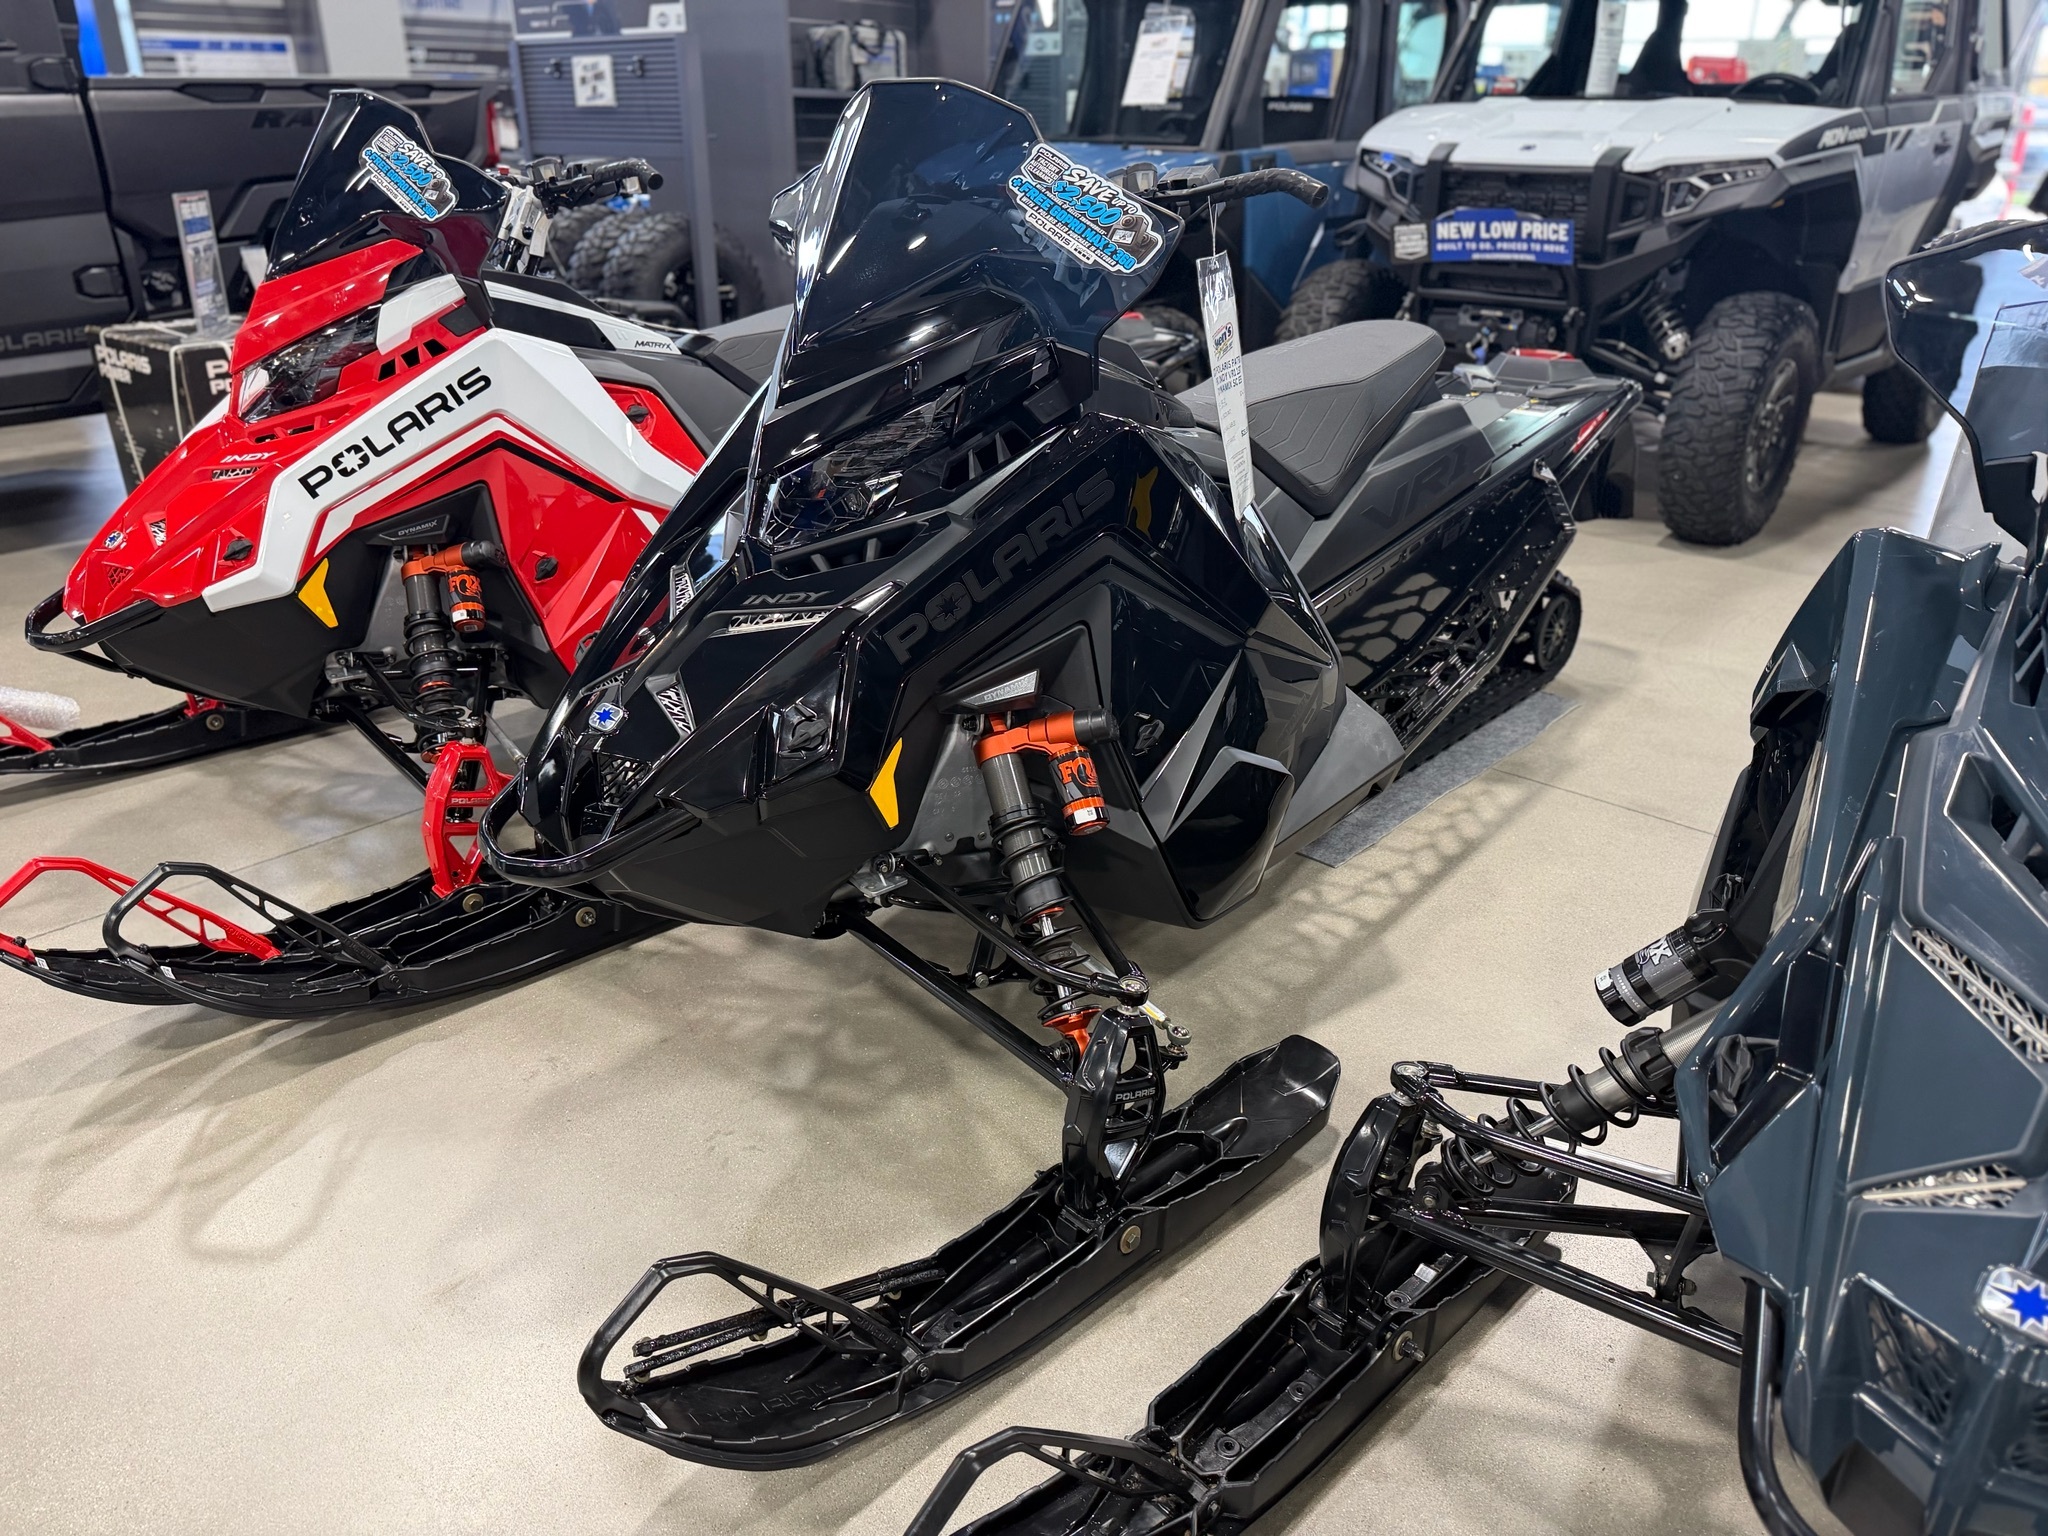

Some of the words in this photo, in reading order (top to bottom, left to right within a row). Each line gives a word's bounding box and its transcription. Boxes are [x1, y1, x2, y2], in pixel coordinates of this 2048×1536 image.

[398, 143, 431, 168] SAVE
[1038, 156, 1061, 175] FACTORY
[1039, 148, 1070, 170] POLARIS
[391, 152, 433, 186] $2,500
[1027, 164, 1053, 183] CLEARANCE
[373, 174, 399, 199] POLARIS
[387, 170, 409, 191] GOPRO
[406, 187, 422, 203] MAX
[423, 204, 438, 218] 360
[1063, 168, 1118, 202] SAVE
[1053, 180, 1122, 225] $2,500
[1111, 197, 1126, 209] UP
[1124, 203, 1138, 214] TO
[1021, 196, 1035, 208] WITH
[1038, 209, 1057, 224] POLARIS
[1067, 230, 1092, 248] PURCHASE
[1028, 213, 1072, 246] POLARIS
[1436, 221, 1476, 240] NEW
[1479, 221, 1517, 240] LOW
[1521, 222, 1569, 242] PRICE
[1049, 205, 1086, 234] GOPRO
[1082, 228, 1110, 251] MAX
[1104, 243, 1117, 256] 2
[1112, 249, 1137, 270] 360
[634, 340, 673, 351] MATRYX
[95, 344, 152, 375] POLARIS
[98, 363, 132, 384] POWER
[297, 366, 492, 499] POLARIS
[220, 450, 277, 463] INDY
[398, 520, 437, 536] DYNAMIX
[883, 467, 1116, 665] POLARIS
[740, 589, 835, 606] INDY
[1115, 1087, 1156, 1101] POLARIS
